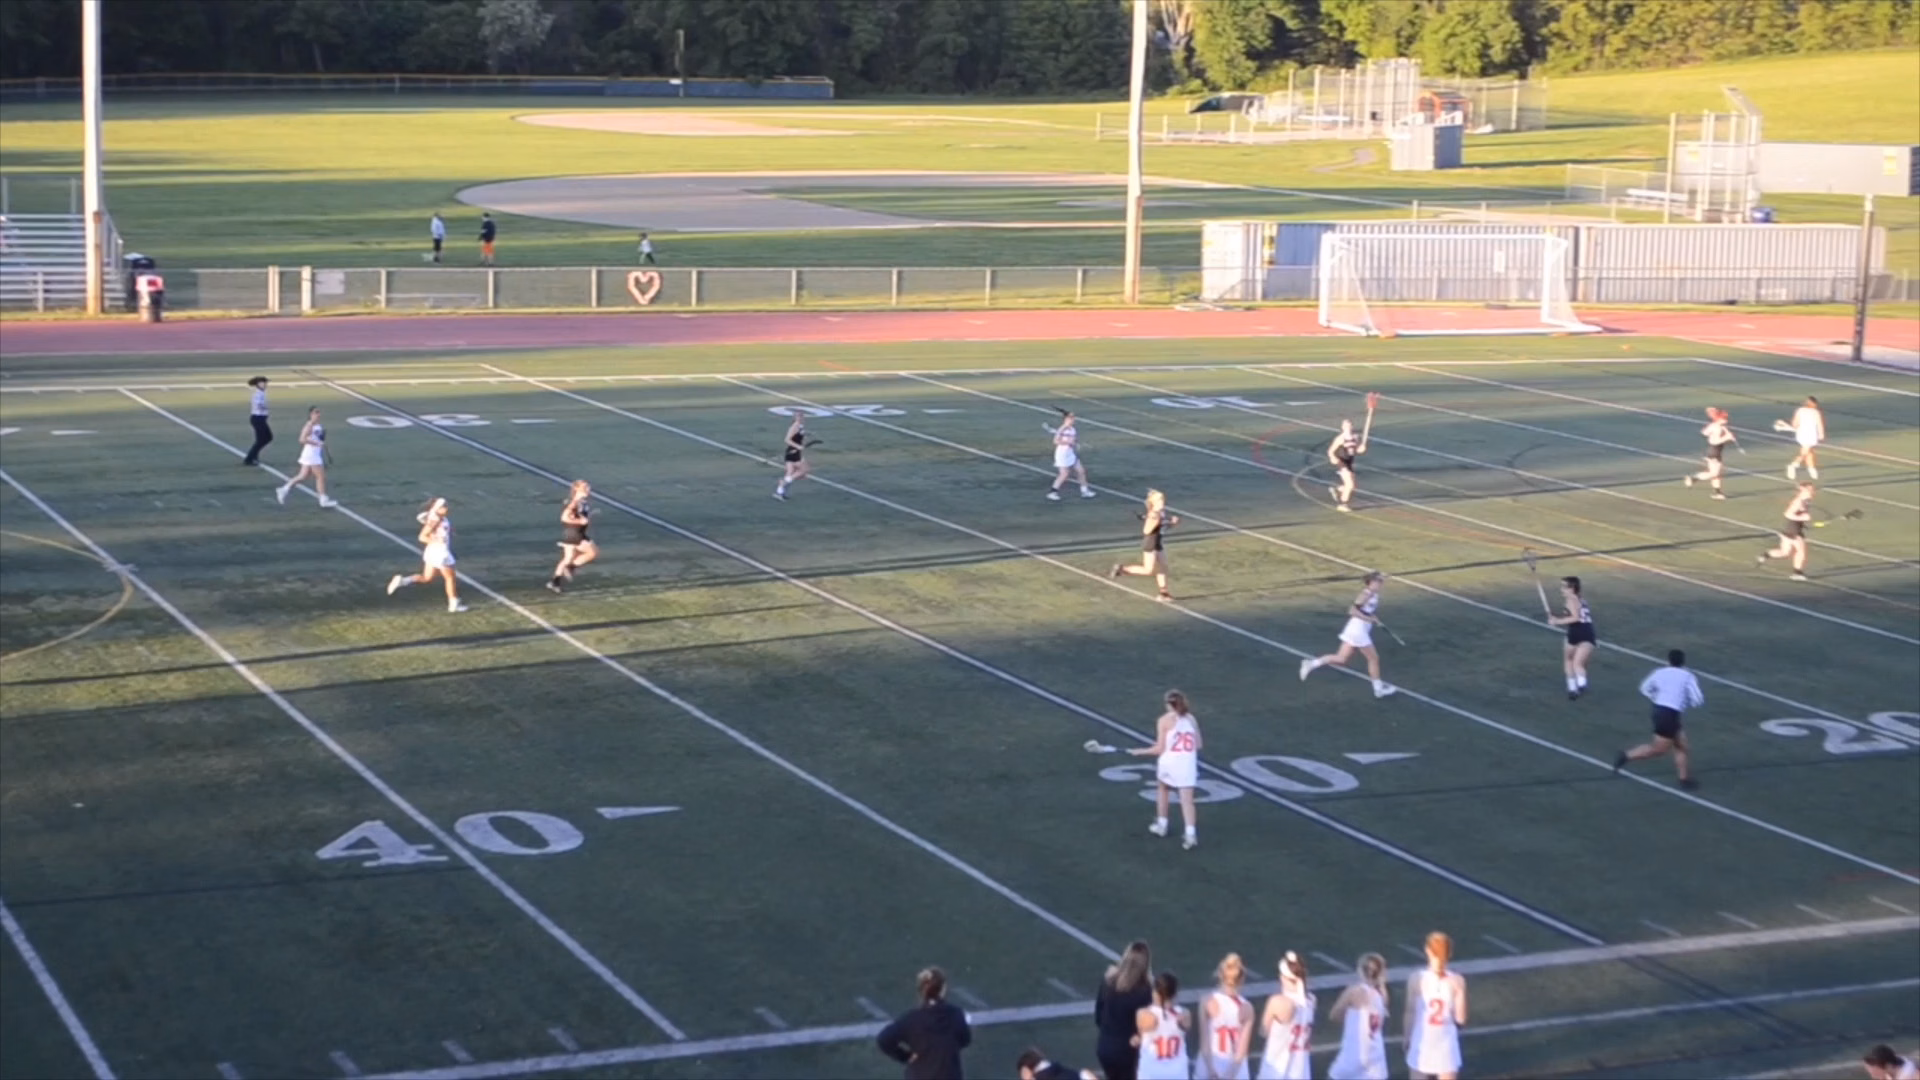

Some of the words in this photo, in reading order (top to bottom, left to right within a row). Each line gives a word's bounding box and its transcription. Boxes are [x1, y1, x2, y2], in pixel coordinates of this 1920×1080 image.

[1171, 732, 1195, 752] 26
[1099, 755, 1360, 803] 30
[315, 810, 585, 867] 40
[1428, 999, 1445, 1025] 2
[1154, 1035, 1181, 1060] 10
